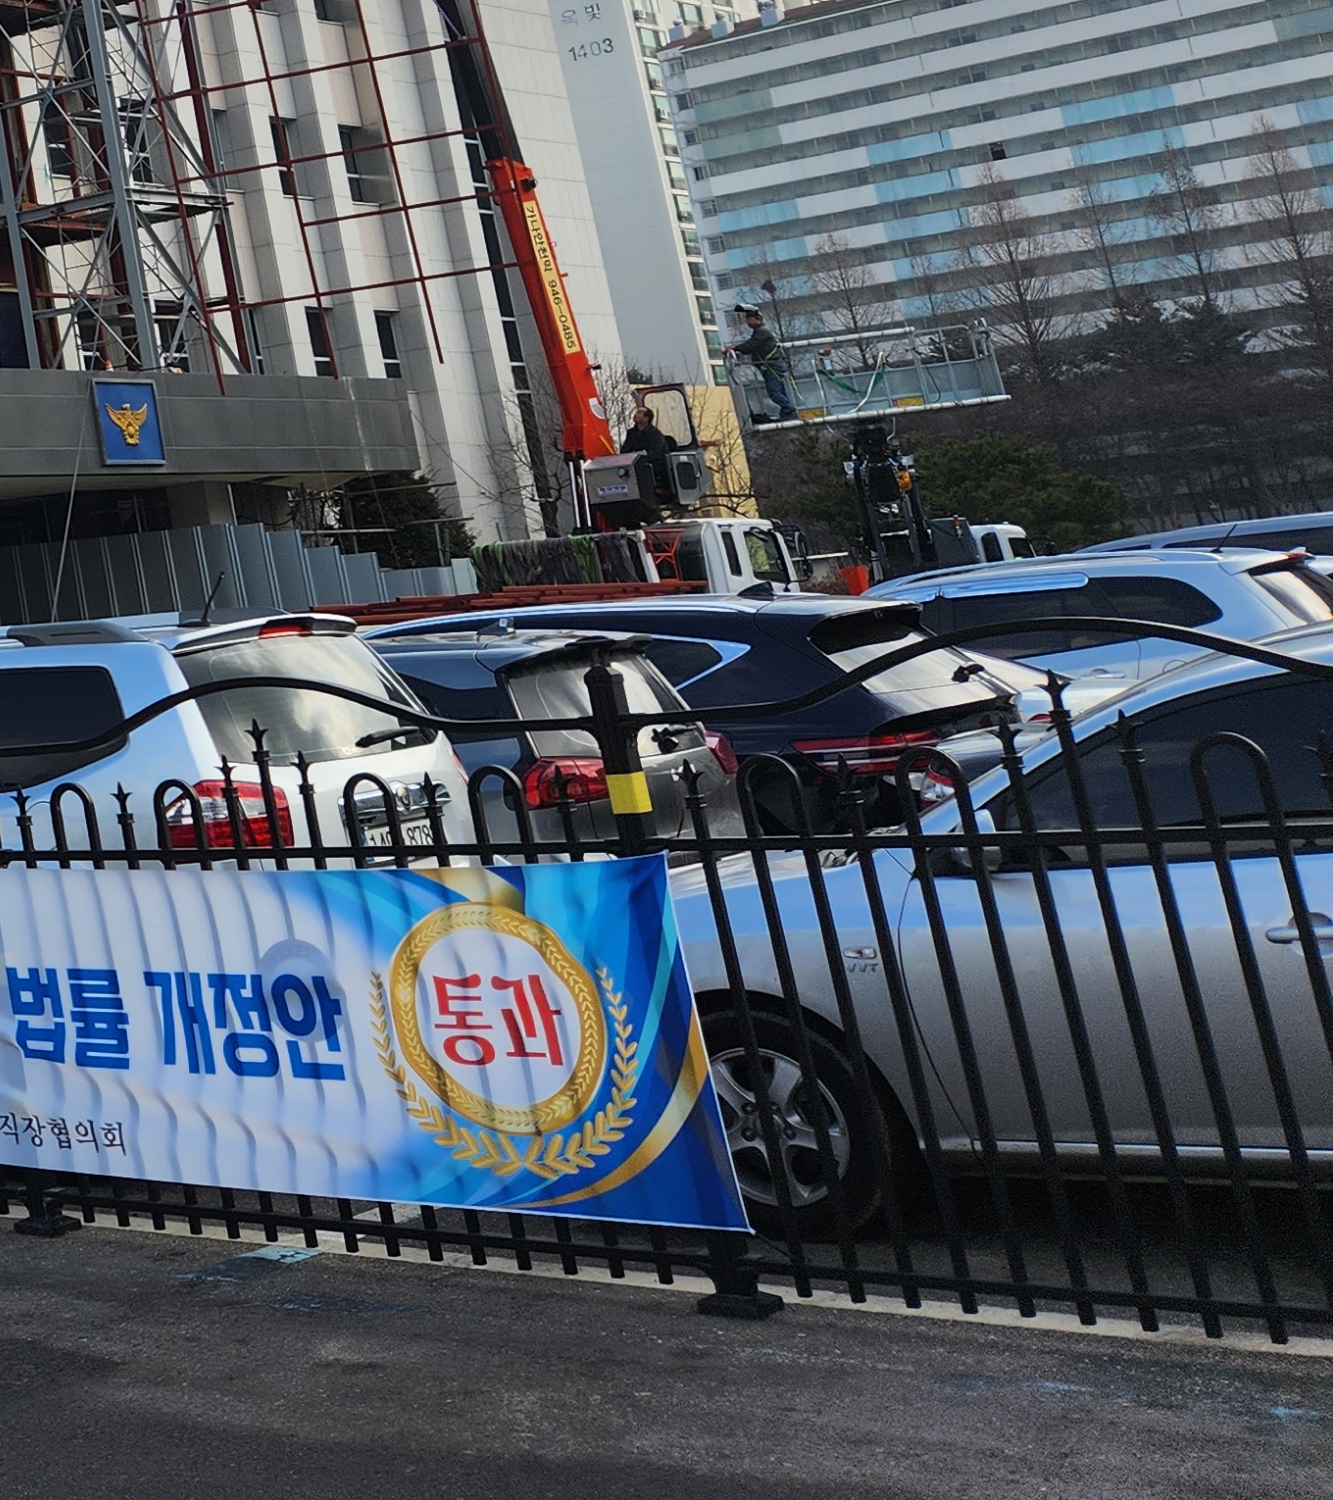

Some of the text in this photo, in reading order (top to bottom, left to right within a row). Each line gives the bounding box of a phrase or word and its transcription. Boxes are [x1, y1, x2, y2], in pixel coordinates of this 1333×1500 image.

[568, 37, 614, 61] 1403
[526, 205, 576, 349] 가나안천막 946-0485
[6, 967, 130, 1070] 법률
[143, 971, 346, 1081] 개정안
[432, 973, 564, 1066] 통과
